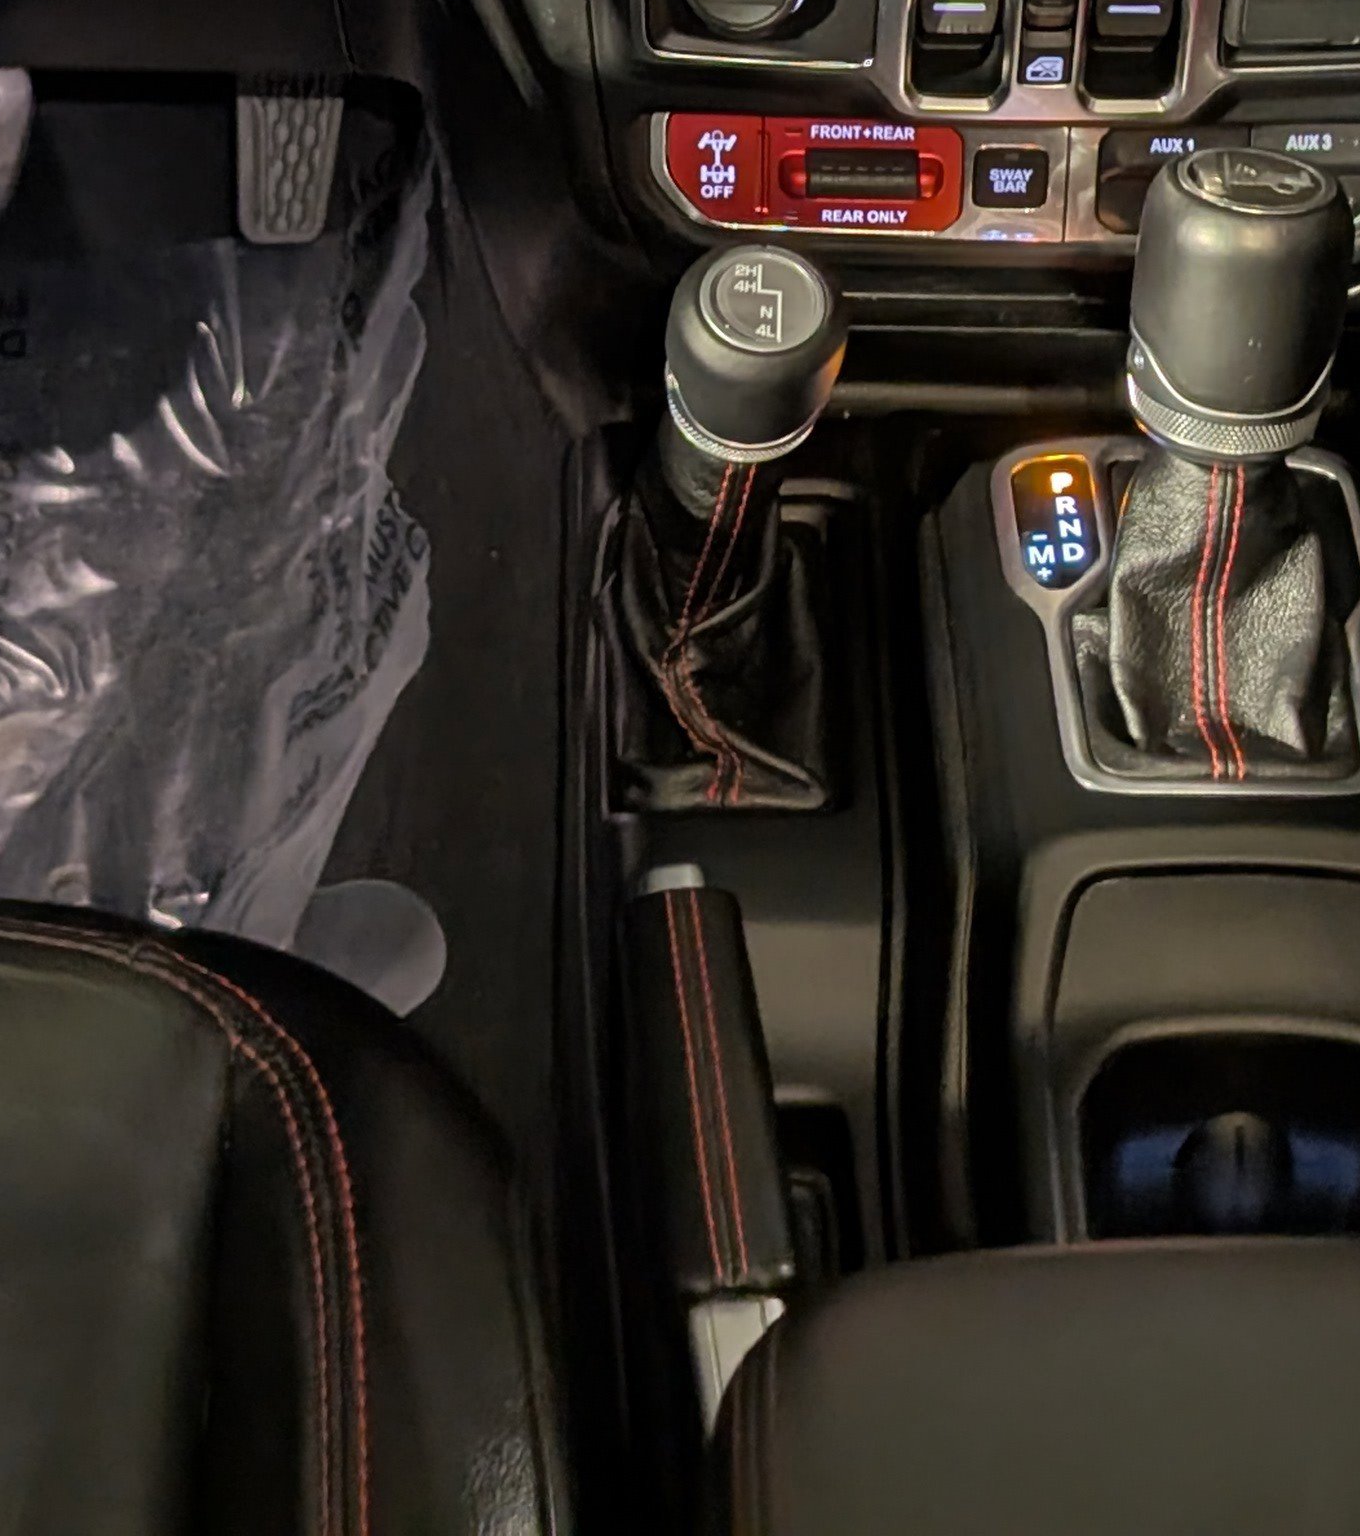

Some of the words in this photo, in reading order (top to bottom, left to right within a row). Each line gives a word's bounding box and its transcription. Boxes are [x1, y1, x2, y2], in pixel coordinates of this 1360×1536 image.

[1149, 138, 1184, 154] AUX
[1285, 134, 1321, 152] AUX
[1323, 133, 1333, 151] 3
[988, 168, 1033, 183] SWAY
[700, 185, 733, 199] OFF
[993, 180, 1027, 194] BAR
[821, 209, 864, 223] REAR
[867, 209, 908, 225] ONLY
[733, 279, 757, 294] 4H
[759, 304, 774, 319] N
[754, 323, 776, 338] 4L
[1050, 471, 1073, 494] P
[1055, 495, 1077, 514] R
[1058, 518, 1082, 538] N
[1027, 544, 1056, 565] M
[1061, 542, 1085, 562] D
